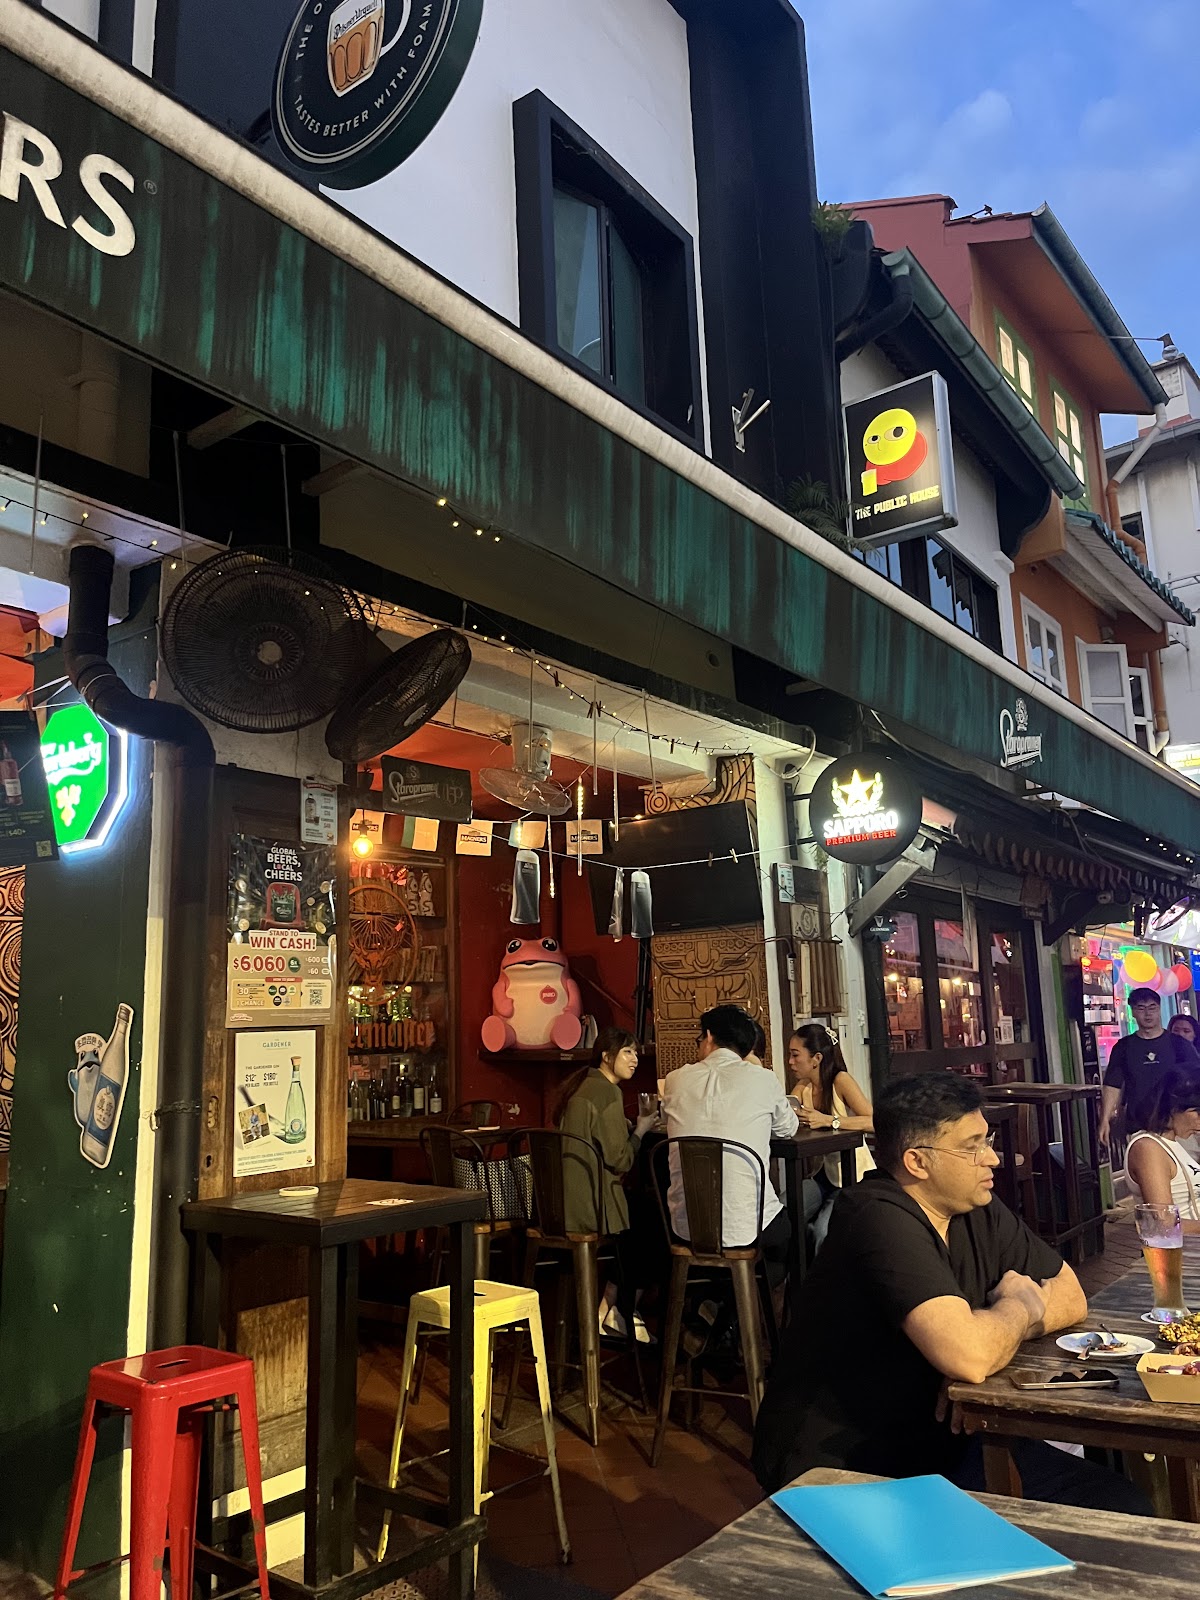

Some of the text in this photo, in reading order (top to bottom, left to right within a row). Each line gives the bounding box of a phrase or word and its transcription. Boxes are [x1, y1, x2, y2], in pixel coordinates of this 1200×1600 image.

[296, 24, 313, 60] THE
[294, 3, 433, 137] TASTES BETTER WITH FOAM
[855, 485, 940, 521] THE PUBLIC HOUSE
[388, 771, 441, 803] Staropramen
[823, 810, 899, 839] SAPPORO
[461, 834, 487, 843] MAGNERS
[571, 834, 598, 842] MGNERS
[826, 829, 897, 846] PREMIUM BEER
[271, 847, 296, 855] GLOBAL
[267, 853, 301, 867] BEERS,
[273, 863, 294, 872] LOCAL
[264, 869, 303, 881] CHEERS
[250, 936, 316, 950] WIN CASH!
[233, 955, 286, 973] $6,060
